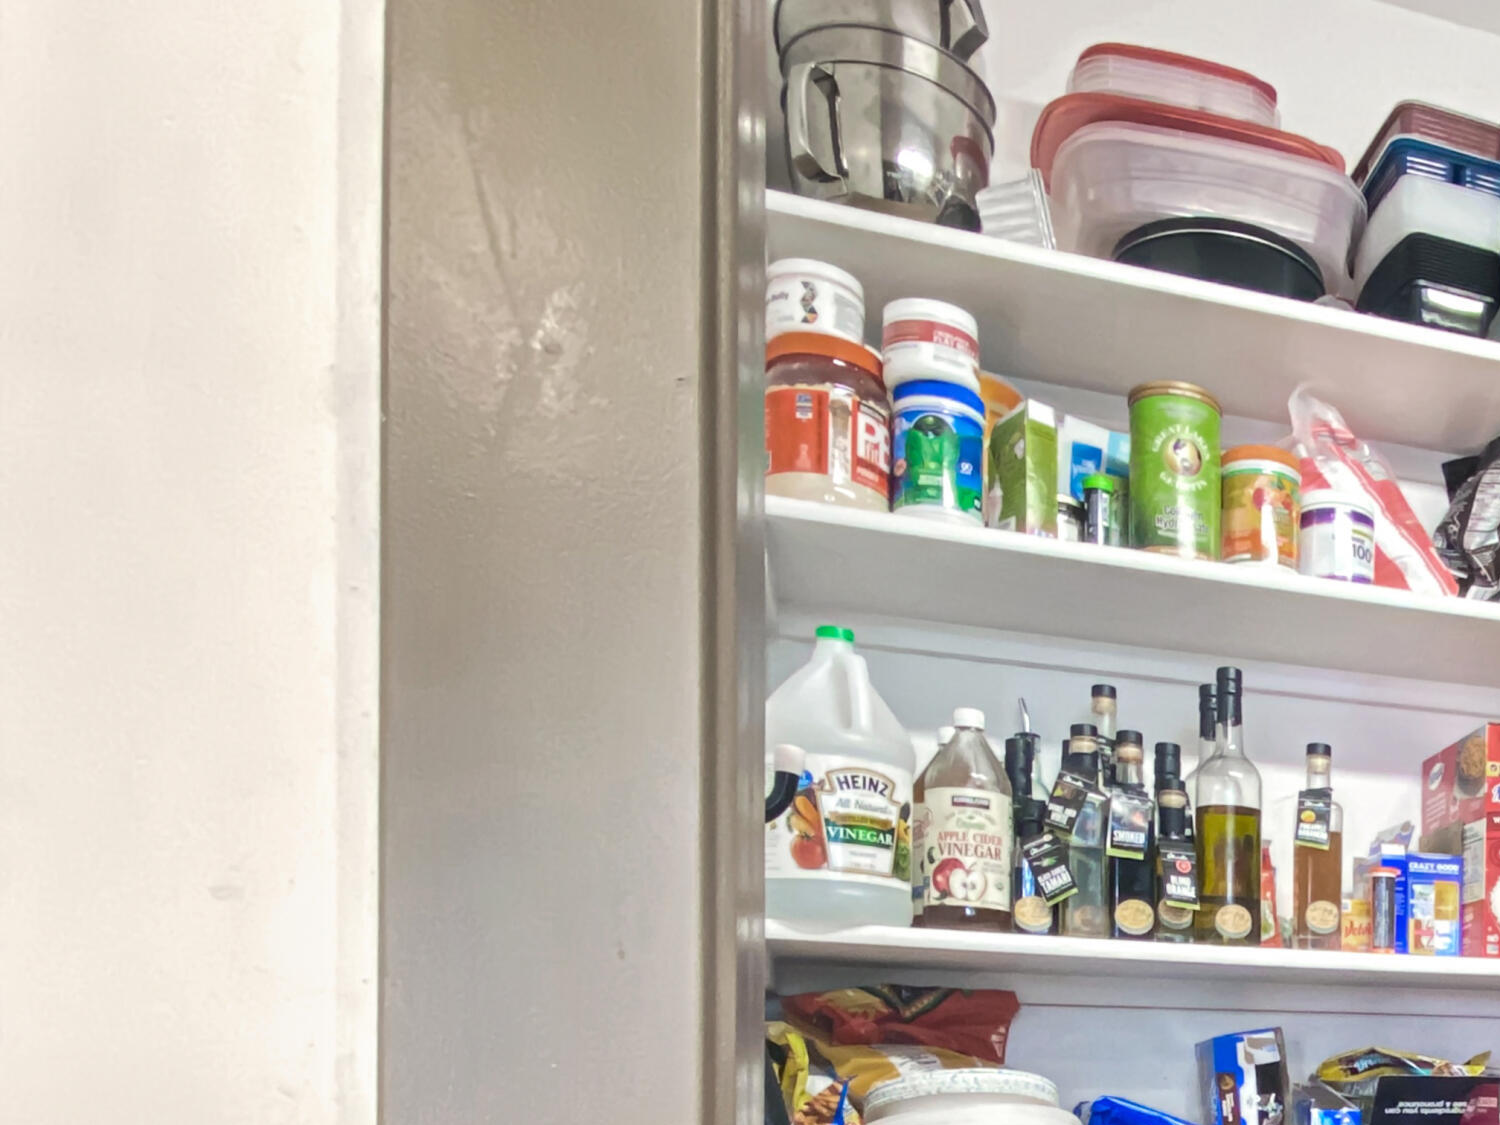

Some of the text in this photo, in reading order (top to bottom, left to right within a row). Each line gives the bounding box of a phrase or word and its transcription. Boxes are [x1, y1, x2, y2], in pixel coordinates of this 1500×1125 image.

[1351, 543, 1374, 564] 100
[836, 775, 889, 797] HEINZ
[826, 825, 894, 846] VINEGAR
[937, 831, 1004, 847] APPLE CIDER
[937, 842, 1003, 861] VINEGAR
